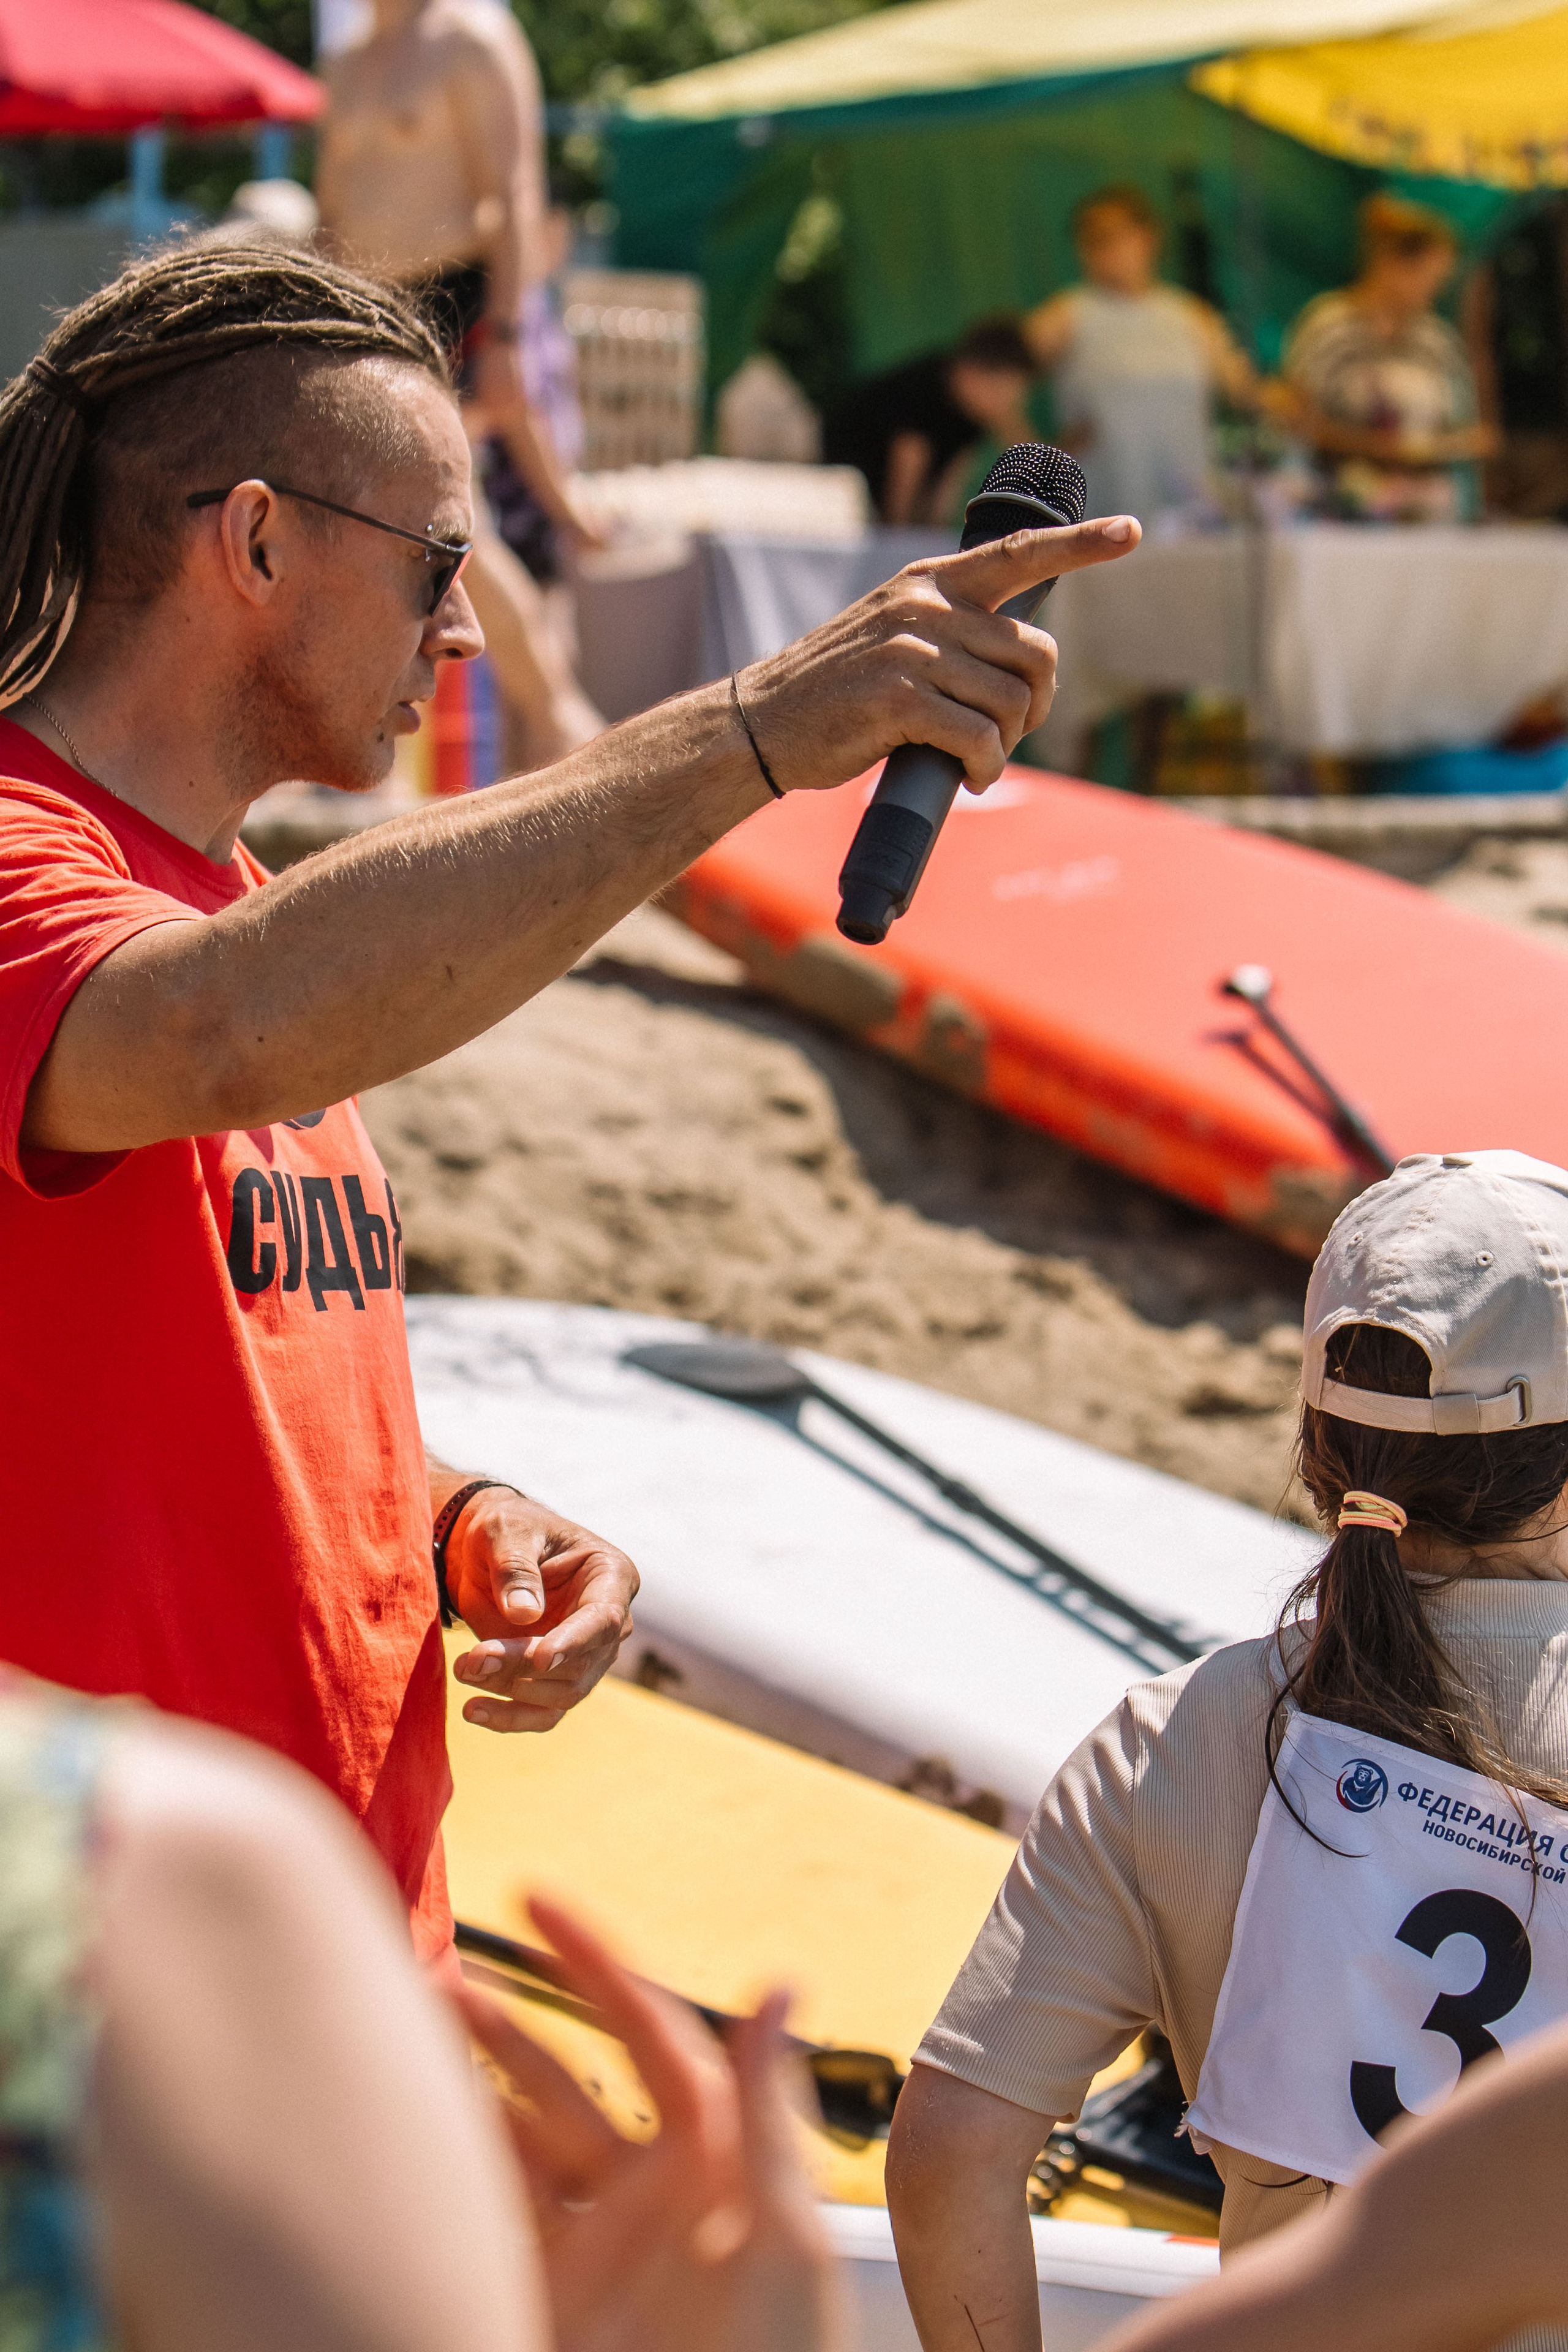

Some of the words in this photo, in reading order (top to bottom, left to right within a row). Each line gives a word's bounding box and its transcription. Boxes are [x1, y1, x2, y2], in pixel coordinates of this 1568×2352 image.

[1397, 1782, 1555, 1856] ФЕДЕРАЦИЯ
[1422, 1819, 1566, 1884] НОВОСИБИРСКОЙ
[1349, 1888, 1532, 2150] 3
